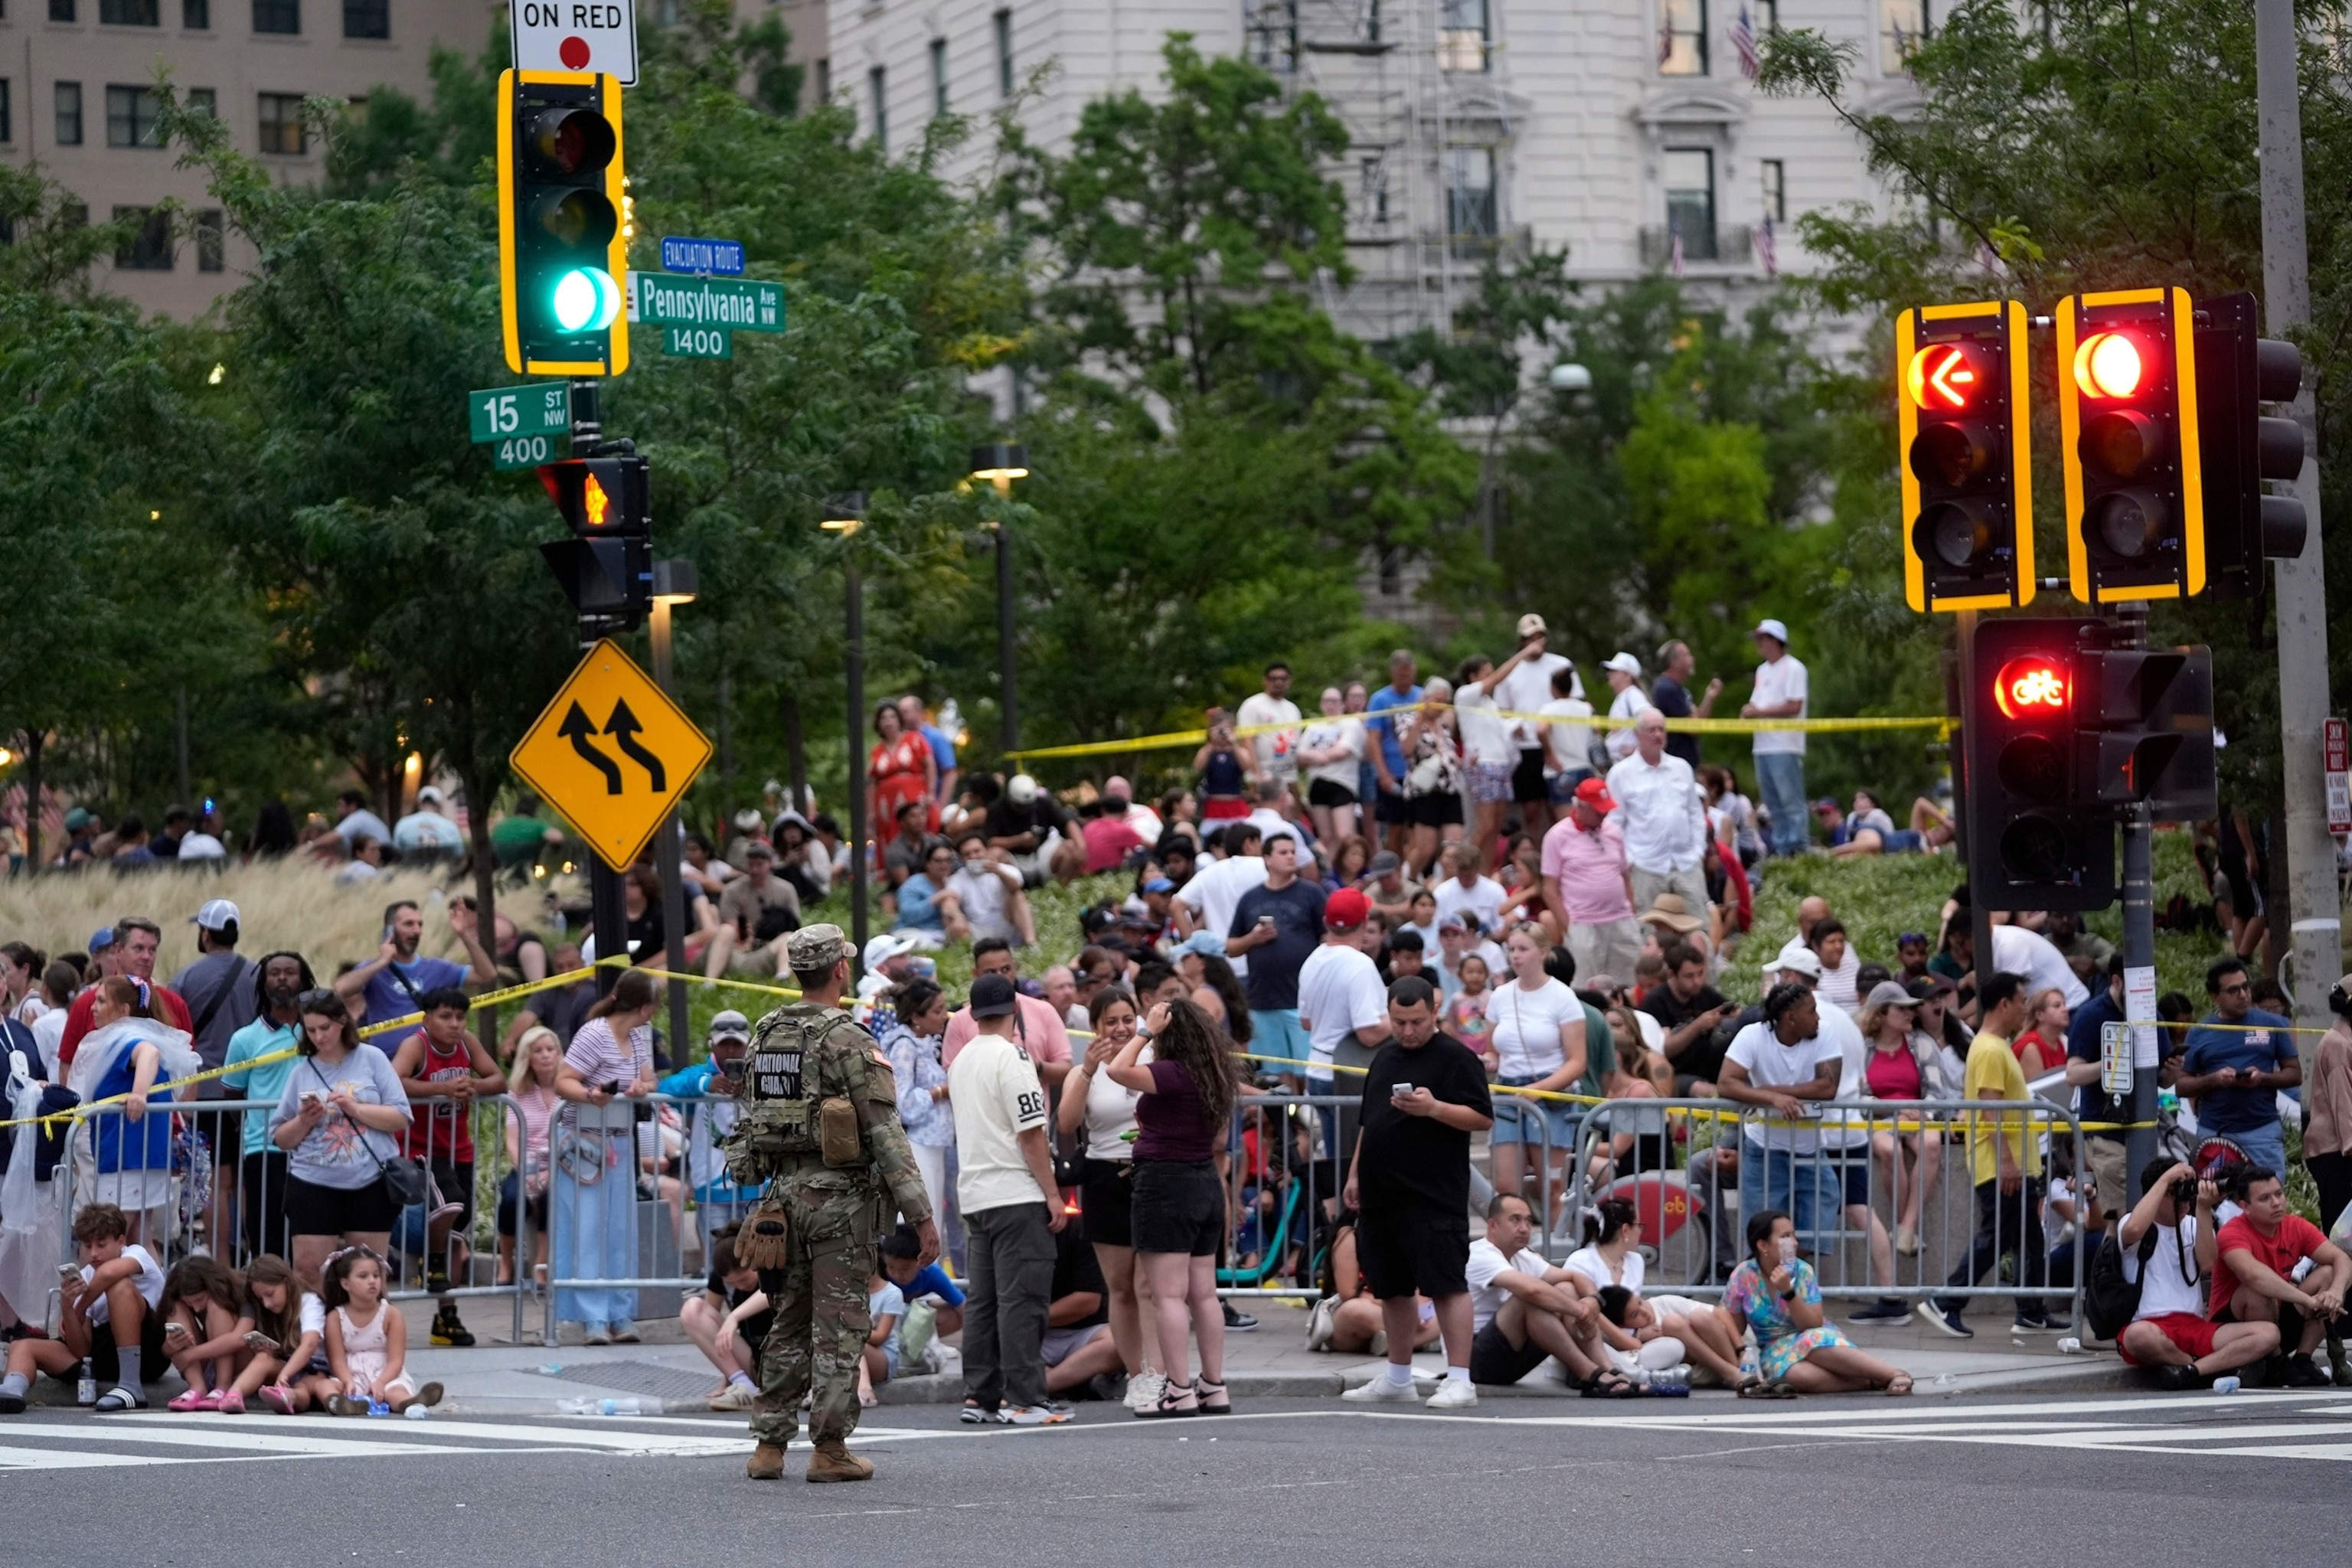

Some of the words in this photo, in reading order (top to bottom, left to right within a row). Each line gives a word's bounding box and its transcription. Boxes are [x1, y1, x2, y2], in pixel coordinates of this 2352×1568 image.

[524, 3, 559, 28] ON
[573, 5, 622, 29] RED
[665, 241, 714, 268] EVACUATION
[715, 245, 740, 270] ROUTE
[644, 278, 755, 324] Pennsylvania
[760, 286, 776, 306] Ave
[761, 306, 776, 325] NW
[673, 328, 723, 355] 1400
[483, 394, 519, 433] 15
[545, 390, 563, 408] ST
[544, 409, 565, 426] NW
[501, 436, 547, 464] 400
[754, 1054, 800, 1073] NATIONAL
